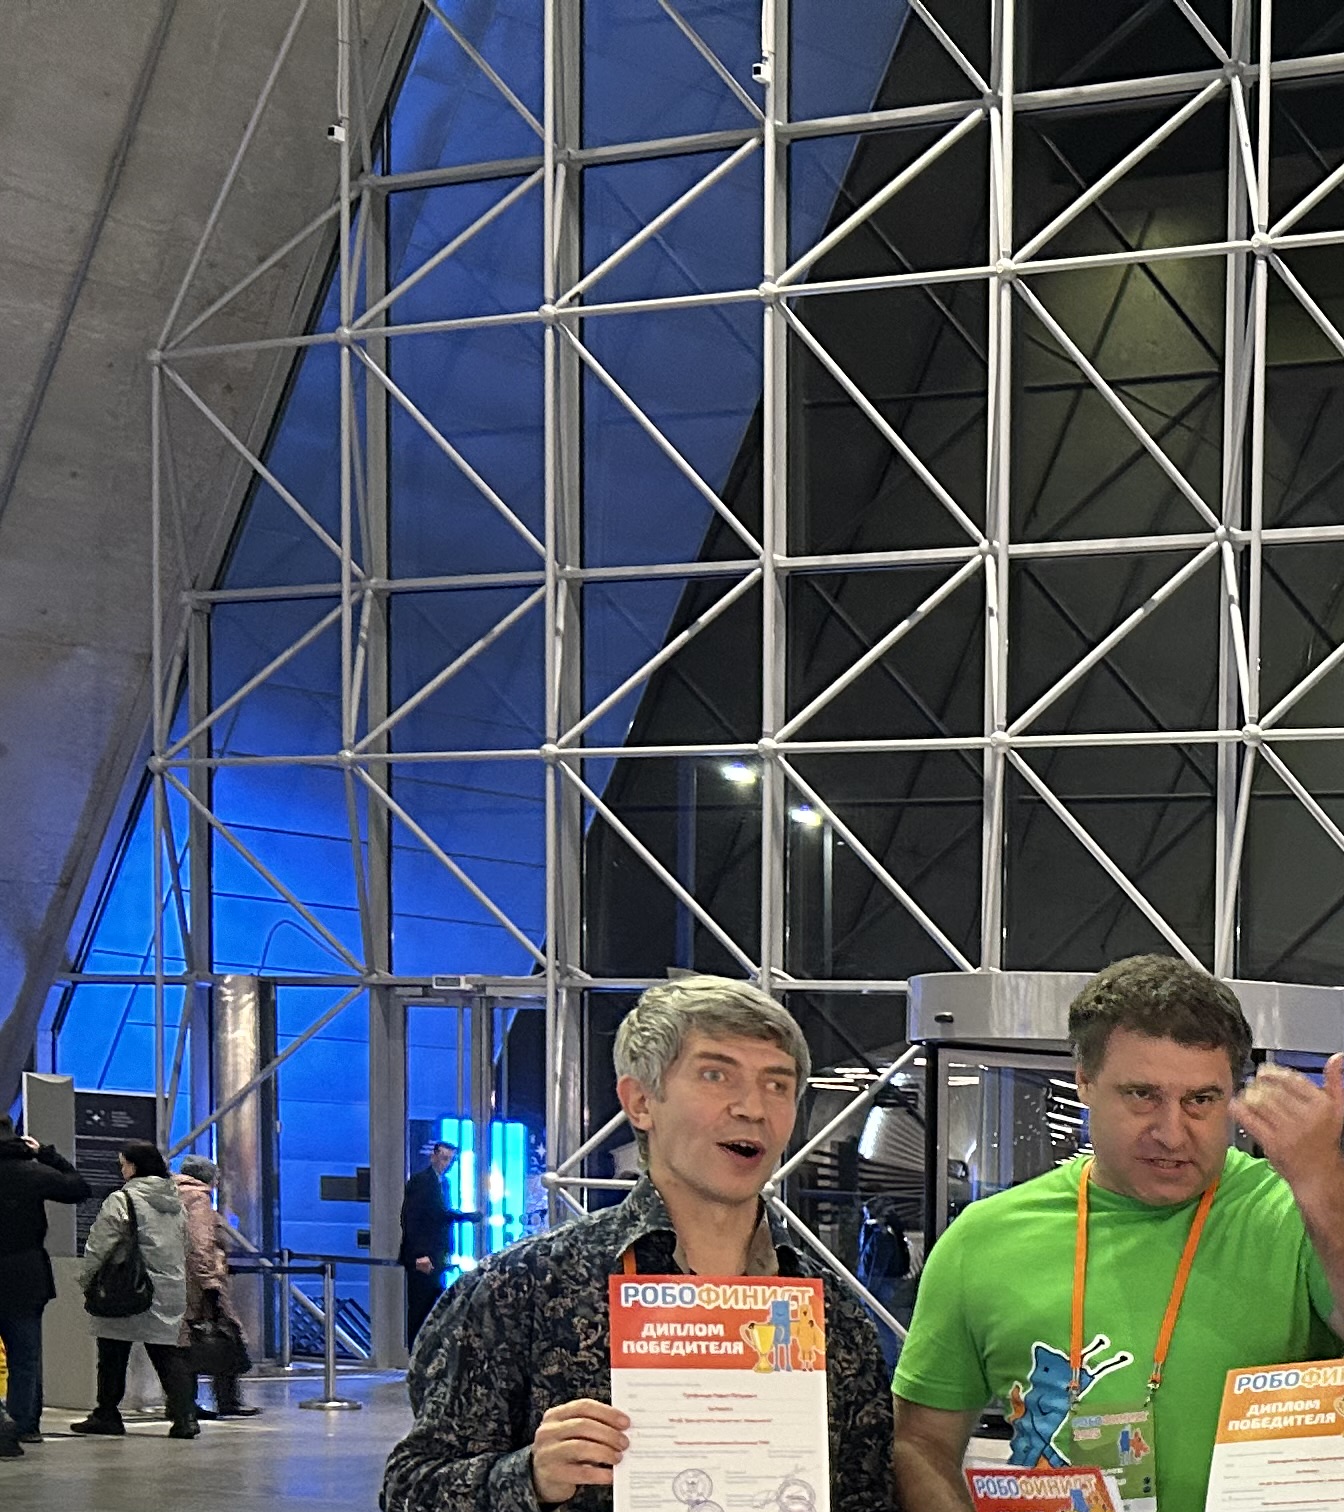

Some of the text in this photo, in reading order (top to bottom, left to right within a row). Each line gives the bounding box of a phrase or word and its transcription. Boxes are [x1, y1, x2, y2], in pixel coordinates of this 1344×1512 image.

[620, 1283, 814, 1311] РОБОФИНИСТ
[641, 1323, 725, 1338] ДИПЛОМ
[622, 1340, 745, 1356] ПОБЕДИТЕЛЯ
[1246, 1399, 1321, 1417] ДИПЛОМ
[1228, 1412, 1337, 1431] ПОБЕДИТЕЛЯ
